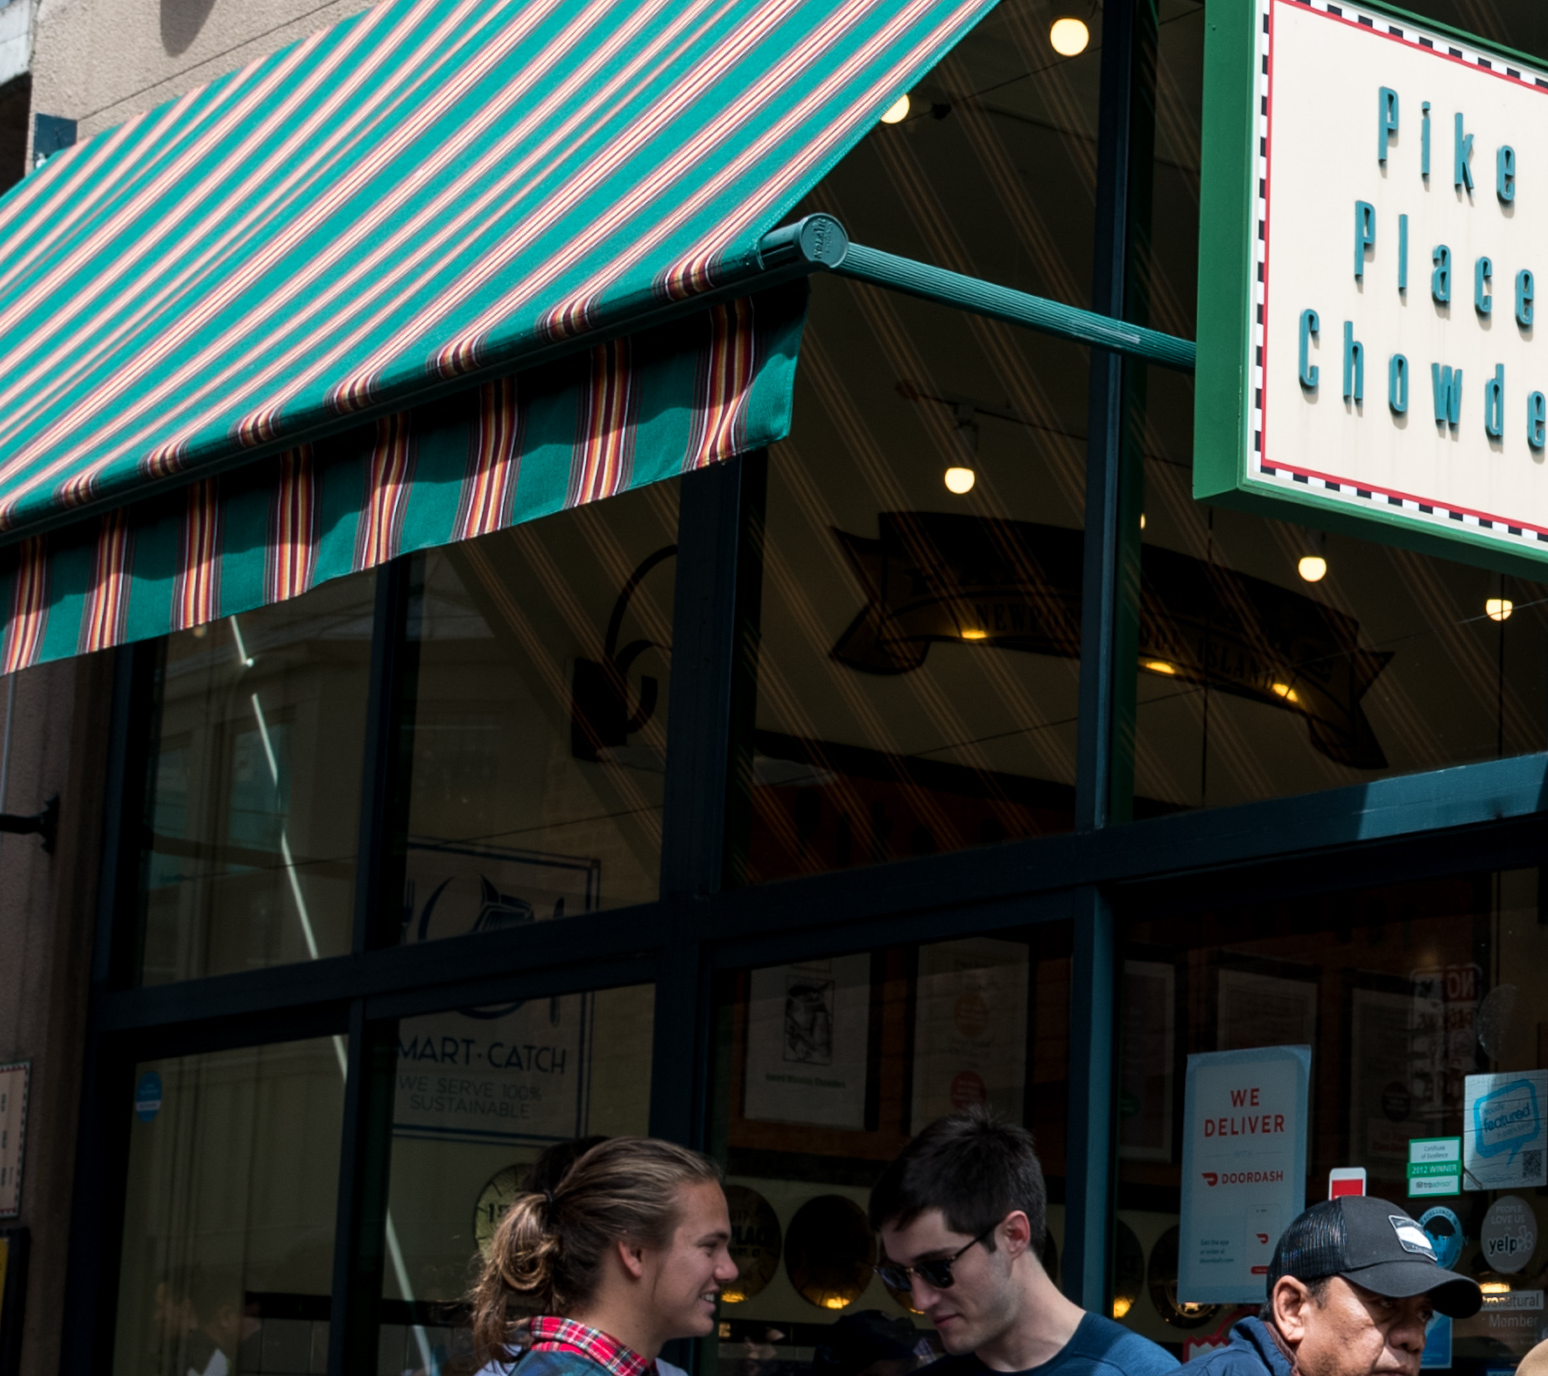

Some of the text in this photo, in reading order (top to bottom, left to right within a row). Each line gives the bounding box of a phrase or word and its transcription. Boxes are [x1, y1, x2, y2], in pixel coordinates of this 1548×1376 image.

[1378, 86, 1516, 203] Pike
[1354, 200, 1535, 330] Place
[397, 1036, 475, 1067] MART
[398, 1078, 542, 1102] WE SERVE 100%
[1230, 1088, 1260, 1108] WE
[409, 1094, 531, 1119] SUSTAINABLE
[1483, 1102, 1531, 1133] featured
[1204, 1114, 1285, 1137] DELIVER
[1221, 1170, 1284, 1185] DOORDASH
[1491, 1215, 1512, 1225] LOVE
[1488, 1235, 1518, 1255] yelp
